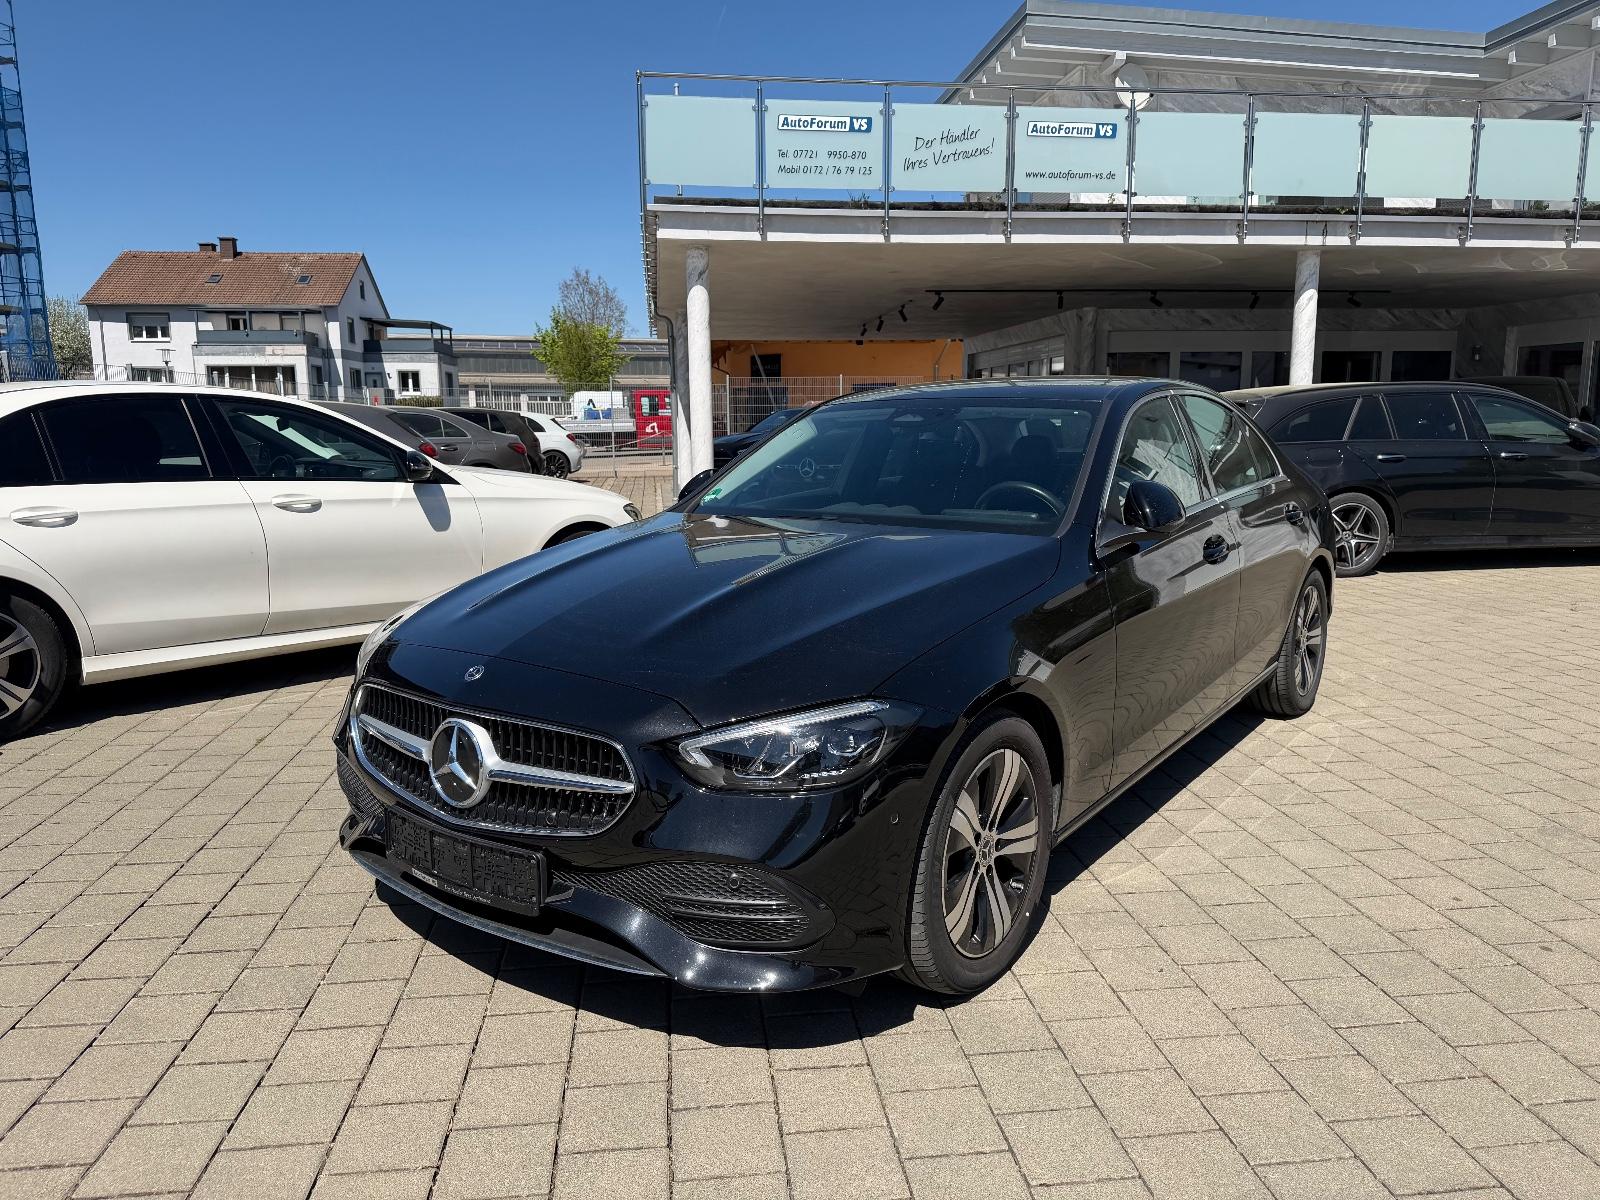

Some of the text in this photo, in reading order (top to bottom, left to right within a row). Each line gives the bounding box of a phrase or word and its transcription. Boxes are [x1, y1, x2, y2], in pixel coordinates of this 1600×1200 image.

[781, 116, 868, 131] AutoForum VS
[1030, 123, 1113, 137] AutoForum VS
[914, 125, 980, 151] Der Händler
[778, 149, 867, 160] Tel. 07721 9950-870
[903, 137, 995, 172] Ihres Vertrauens!
[777, 165, 801, 174] Mobil
[802, 165, 823, 174] 0172
[832, 165, 842, 175] 76
[845, 166, 855, 175] 79
[858, 166, 873, 176] 125
[1025, 169, 1116, 180] www.autoforum-vs.de
